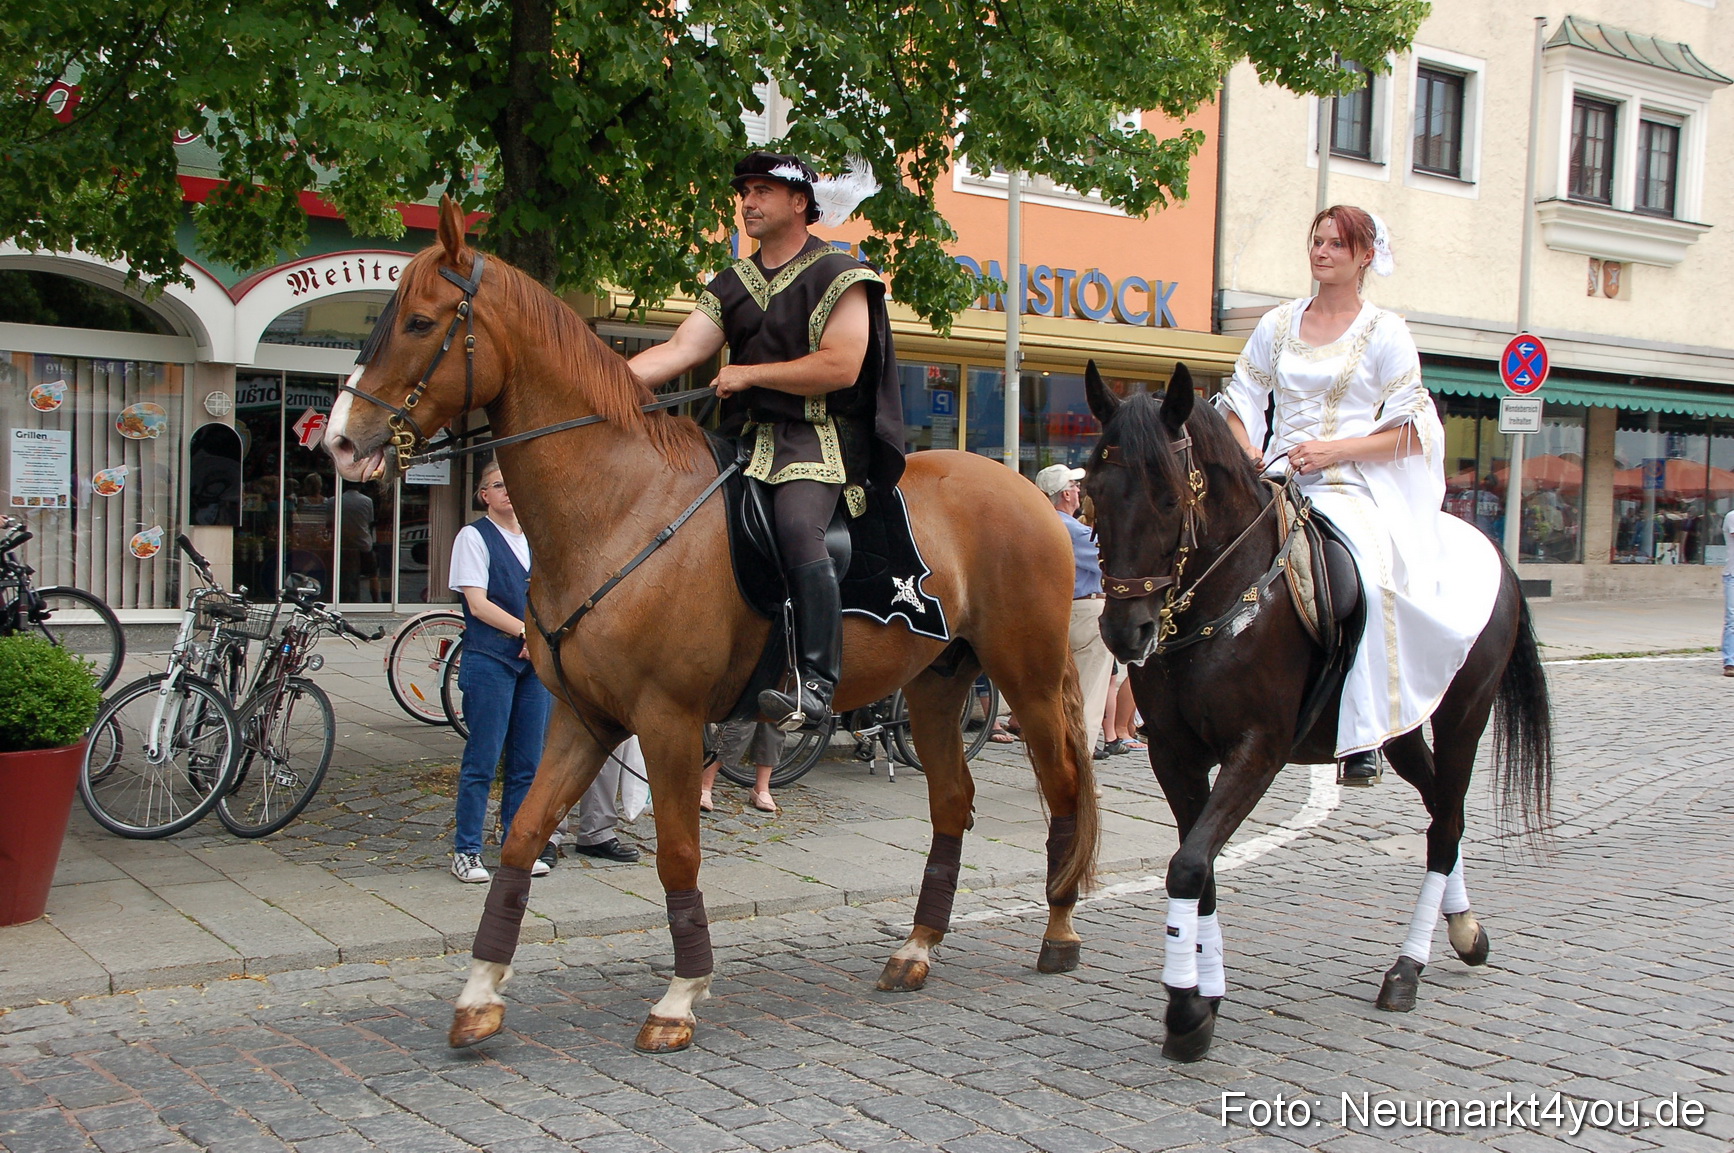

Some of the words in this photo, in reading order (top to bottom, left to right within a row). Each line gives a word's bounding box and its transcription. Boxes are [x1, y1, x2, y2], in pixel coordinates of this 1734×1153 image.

[1504, 404, 1538, 413] Wendebereich
[1508, 417, 1532, 425] freihalten
[15, 430, 48, 440] Grillen
